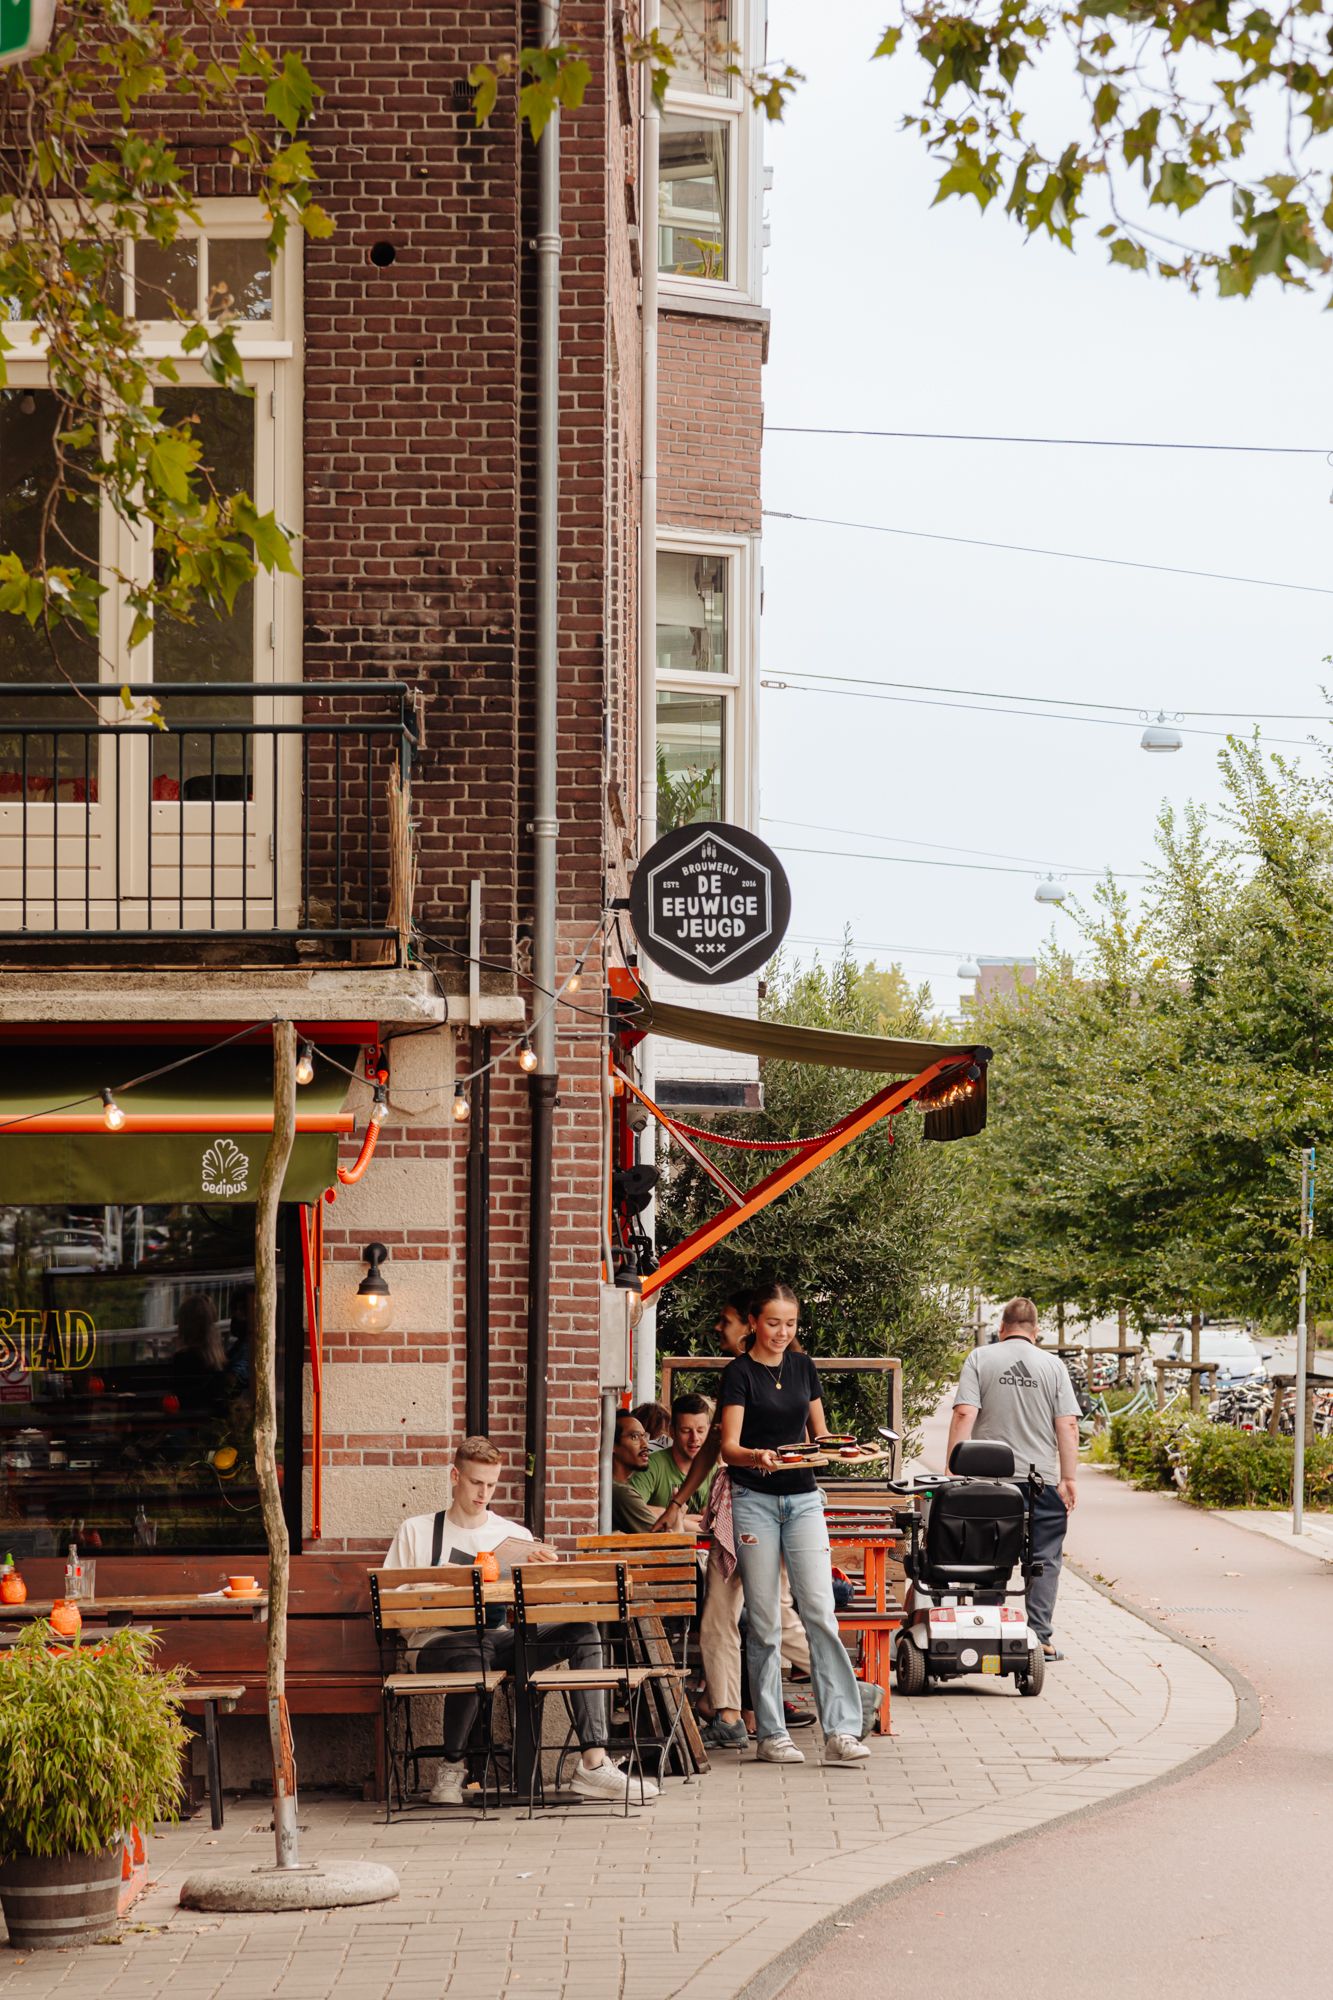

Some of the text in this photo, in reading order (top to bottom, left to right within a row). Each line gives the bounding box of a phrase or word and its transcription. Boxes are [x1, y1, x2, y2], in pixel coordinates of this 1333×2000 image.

[681, 861, 738, 876] BROUWERIJ
[697, 874, 722, 894] DE
[662, 895, 758, 917] EEUWIGE
[677, 918, 746, 938] JEUGD
[202, 1178, 248, 1197] oedipus
[998, 1376, 1038, 1388] adidas
